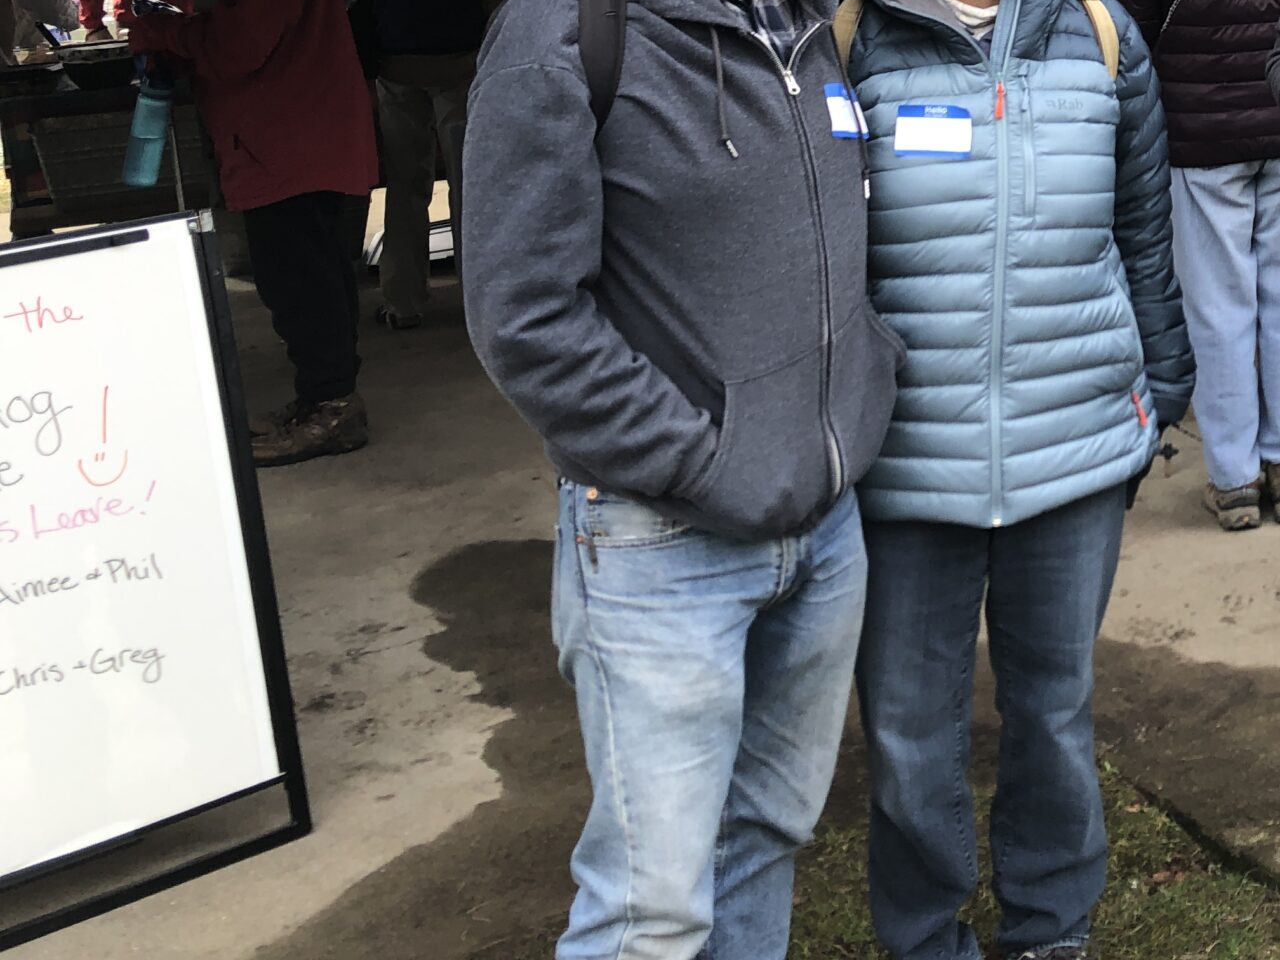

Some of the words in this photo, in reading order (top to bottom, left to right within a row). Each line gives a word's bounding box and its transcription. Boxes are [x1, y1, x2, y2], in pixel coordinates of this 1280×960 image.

[1057, 98, 1084, 111] Rab
[2, 295, 84, 333] the
[0, 390, 73, 457] og
[29, 479, 157, 540] Leave!
[103, 552, 164, 584] Phil
[89, 647, 166, 685] Greg
